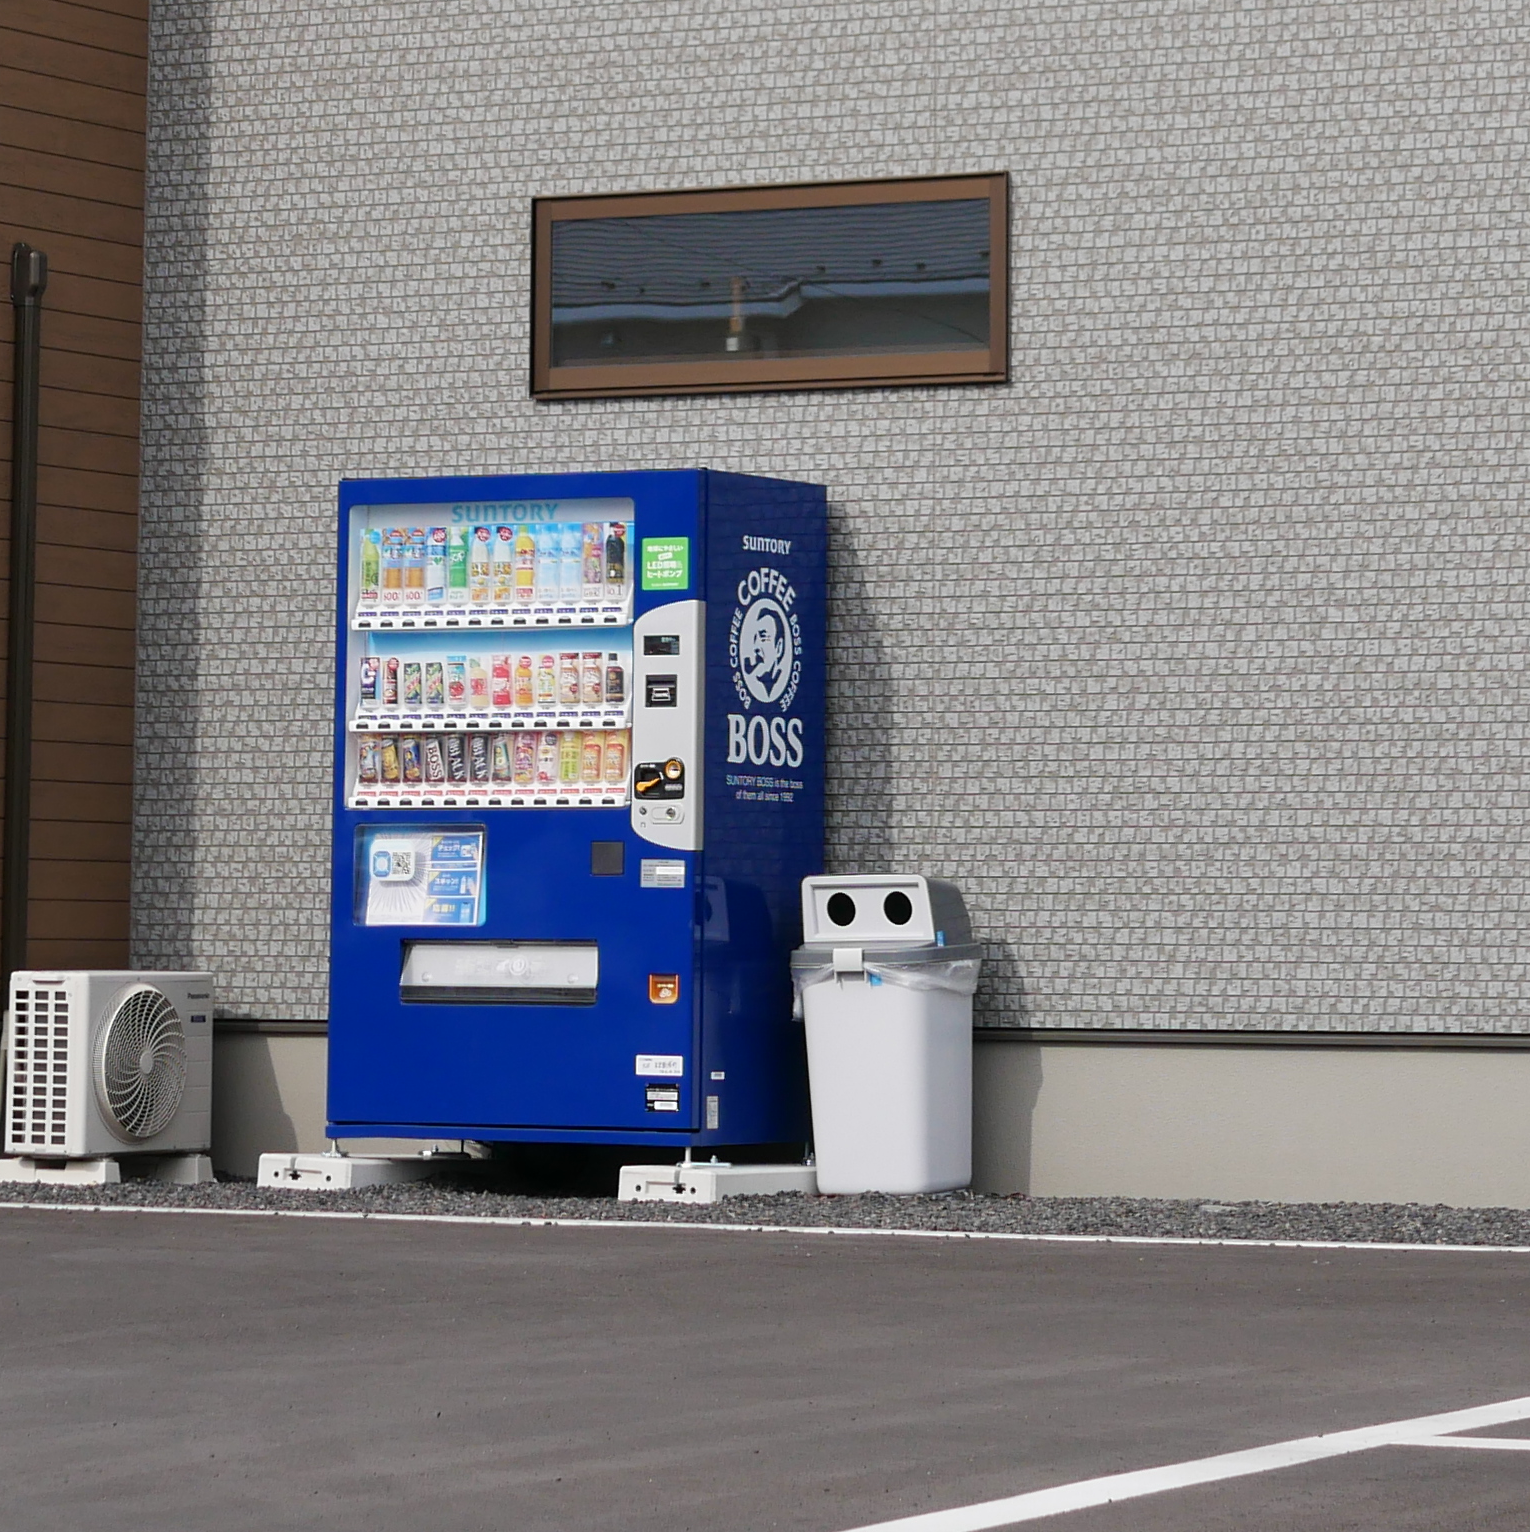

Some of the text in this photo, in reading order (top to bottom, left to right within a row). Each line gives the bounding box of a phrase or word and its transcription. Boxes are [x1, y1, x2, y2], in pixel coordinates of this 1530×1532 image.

[452, 502, 560, 523] SUNTORY
[742, 535, 792, 555] SUNTORY
[737, 567, 796, 611] COFFEE
[729, 607, 752, 709] BOSS COFFEE
[780, 614, 803, 712] BOSS COFFEE
[727, 714, 803, 768] BOSS
[428, 747, 443, 778] BOSS
[726, 774, 756, 786] SUNTORY
[757, 776, 773, 787] BOSS
